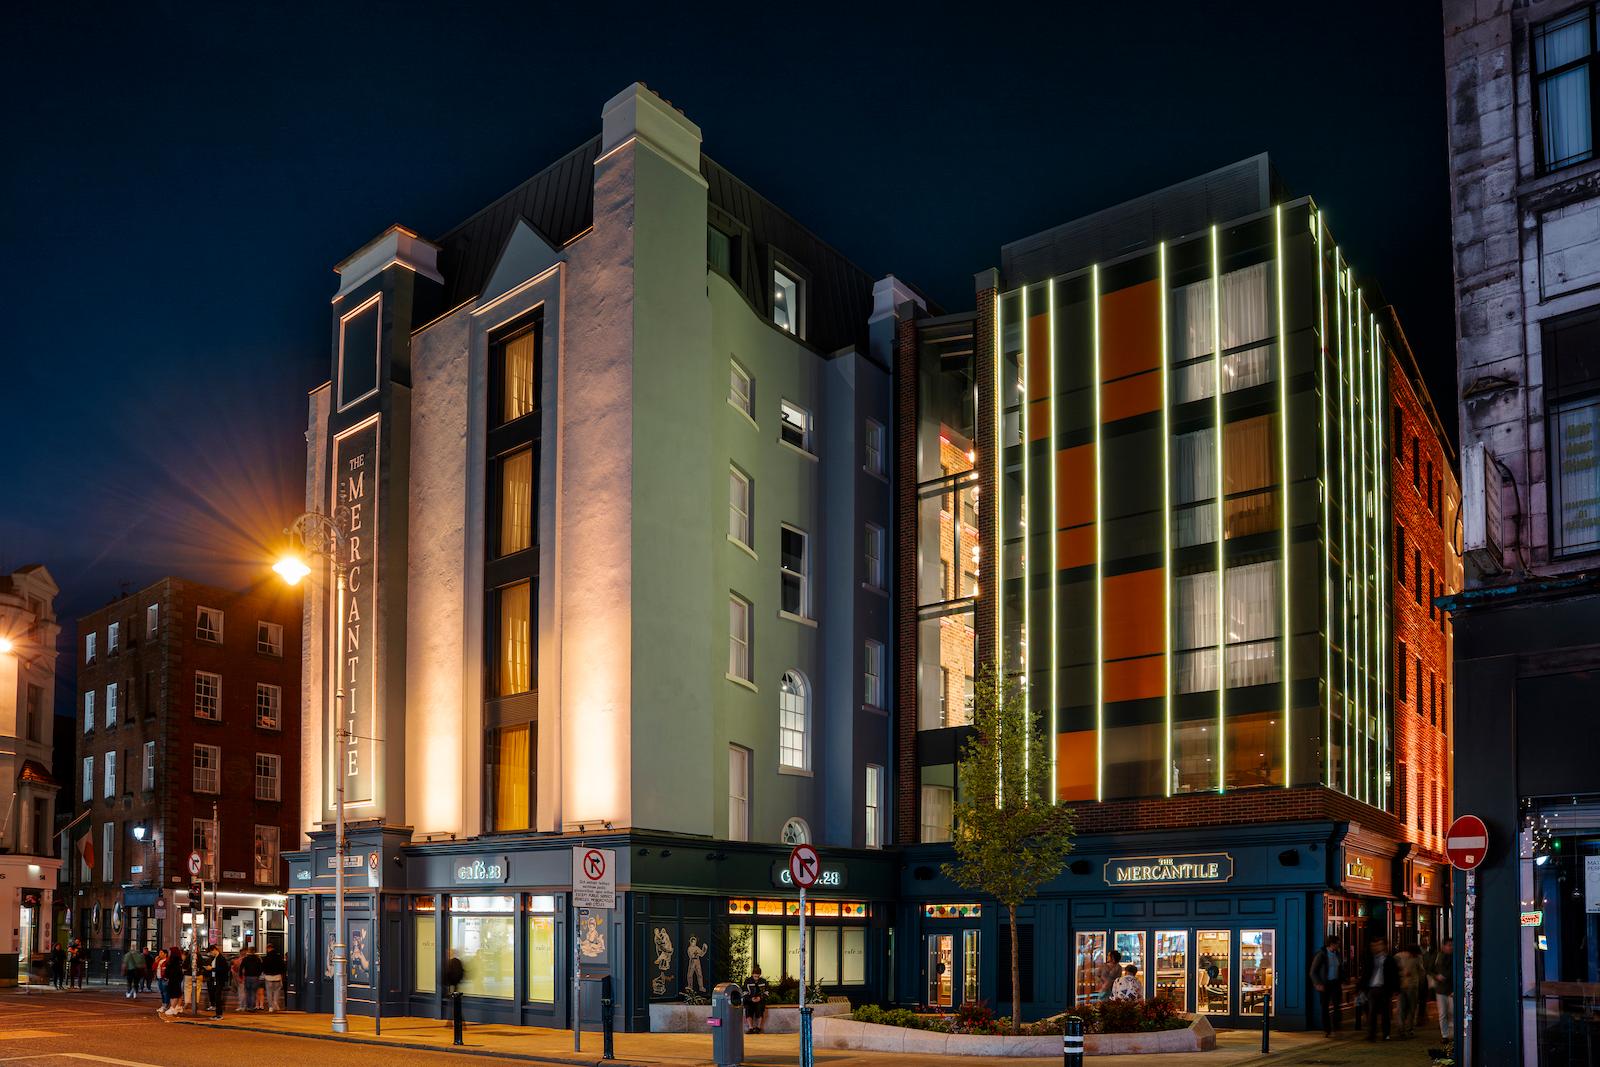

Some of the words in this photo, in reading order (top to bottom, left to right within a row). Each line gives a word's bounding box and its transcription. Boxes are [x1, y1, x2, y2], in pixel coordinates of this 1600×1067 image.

[349, 454, 365, 471] THE
[348, 471, 364, 777] MERCANTILE
[1158, 858, 1174, 866] THE
[1116, 863, 1219, 881] MERCANTILE
